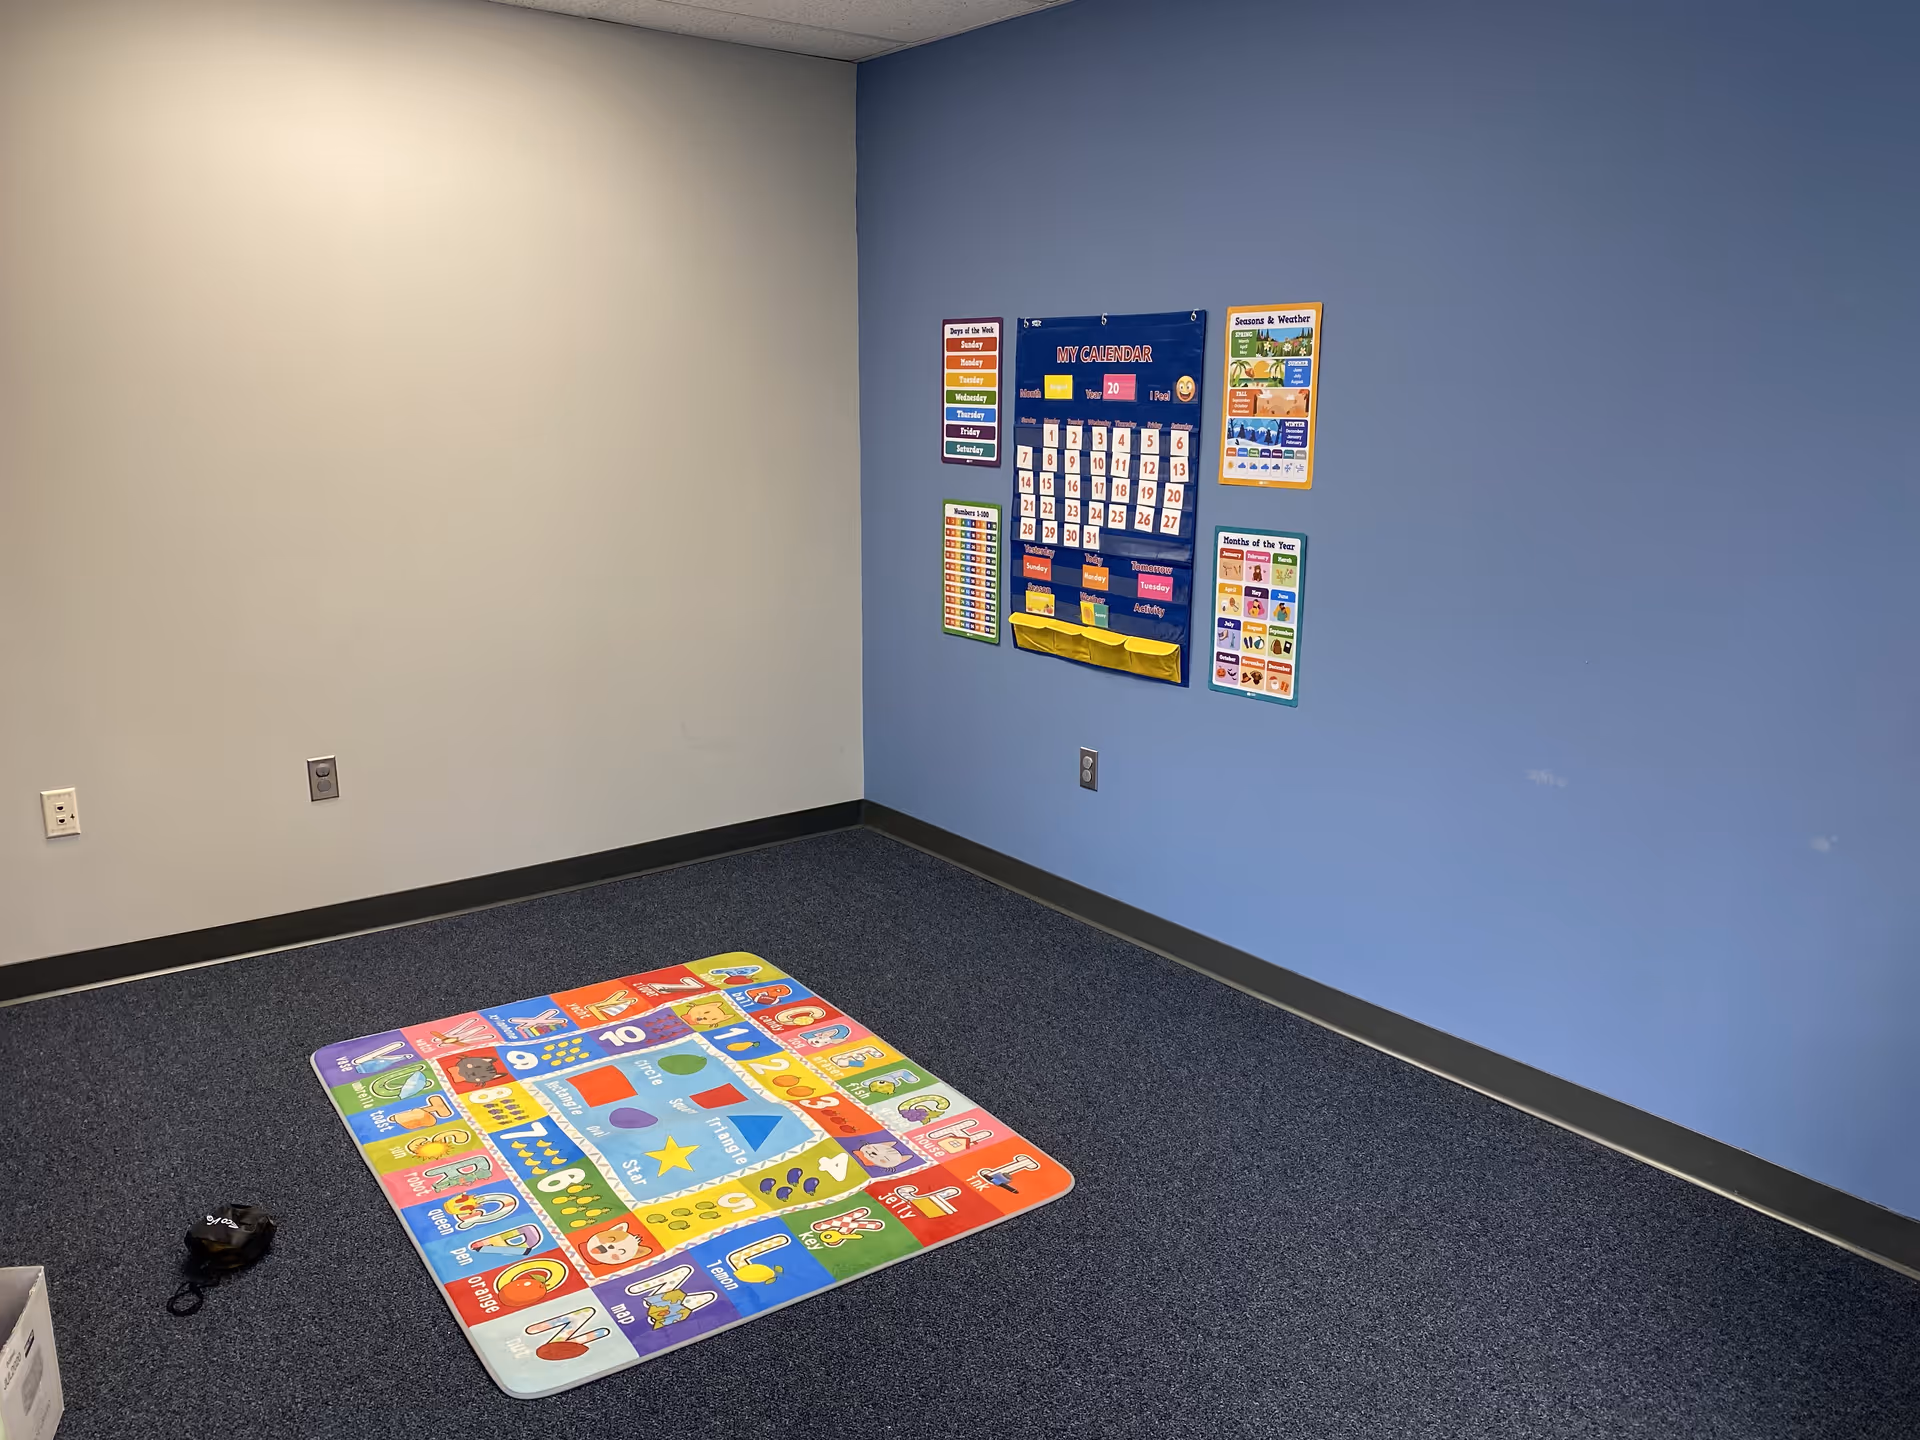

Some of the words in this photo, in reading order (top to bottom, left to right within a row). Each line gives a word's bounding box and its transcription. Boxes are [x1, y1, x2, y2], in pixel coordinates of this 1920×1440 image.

[1235, 316, 1264, 325] Seasons
[1267, 316, 1274, 324] &
[1277, 314, 1310, 324] Weather
[950, 327, 963, 336] Days
[981, 326, 994, 334] Week
[961, 340, 983, 350] Sunday
[1057, 346, 1079, 363] MY
[1080, 345, 1153, 363] CALENDAR
[960, 358, 983, 368] Monday
[959, 376, 984, 385] Tuesday
[955, 393, 987, 404] Wednesday
[1019, 388, 1042, 399] Month
[1085, 389, 1102, 400] Year
[1107, 382, 1120, 395] 20
[1154, 390, 1171, 401] Feel
[956, 410, 985, 421] Thursday
[1115, 420, 1137, 429] Thursday
[1147, 421, 1163, 430] Friday
[1171, 423, 1193, 431] Saturday
[960, 427, 980, 438] Friday
[1050, 430, 1053, 441] 1
[1072, 432, 1077, 443] 2
[1098, 433, 1103, 444] 3
[1118, 434, 1124, 446] 4
[1147, 435, 1153, 447] 5
[1176, 437, 1183, 449] 6
[956, 444, 983, 456] Saturday
[1023, 452, 1028, 462] 7
[1048, 454, 1053, 465] 8
[1070, 456, 1075, 467] 9
[1094, 458, 1104, 469] 10
[1116, 458, 1126, 471] 11
[1144, 462, 1155, 474] 12
[1174, 463, 1185, 476] 13
[1021, 477, 1031, 487] 14
[1042, 478, 1052, 489] 15
[1068, 480, 1078, 492] 16
[1095, 482, 1104, 494] 17
[1116, 484, 1127, 496] 18
[1142, 487, 1154, 499] 19
[1167, 489, 1181, 502] 20
[954, 508, 975, 517] Numbers
[1024, 500, 1033, 511] 21
[1042, 502, 1053, 514] 22
[1067, 505, 1078, 517] 23
[1091, 508, 1102, 520] 24
[1111, 510, 1124, 523] 25
[1138, 512, 1150, 526] 26
[1163, 515, 1178, 528] 27
[1022, 523, 1033, 535] 28
[1045, 527, 1055, 538] 29
[1066, 530, 1077, 542] 30
[1086, 532, 1096, 544] 31
[1223, 536, 1249, 546] Months
[1252, 539, 1260, 547] of
[1263, 539, 1275, 549] the
[1279, 541, 1295, 550] Year
[1024, 543, 1055, 559] Yesterday
[1084, 552, 1103, 567] Today
[1222, 550, 1241, 558] January
[1026, 562, 1048, 574] Sunday
[1084, 572, 1106, 584] Monday
[1131, 561, 1173, 575] Tomorrow
[1027, 582, 1051, 594] Season
[1080, 591, 1105, 604] Weather
[1140, 581, 1170, 594] Tuesday
[1133, 603, 1165, 618] Activity
[1270, 628, 1293, 636] September
[1242, 659, 1264, 667] November
[1268, 664, 1290, 672] December
[648, 977, 705, 995] Z
[745, 984, 793, 1005] B
[584, 990, 638, 1021] Y
[732, 991, 755, 1008] ball
[508, 1009, 568, 1031] X
[566, 1002, 592, 1020] yacht
[775, 1006, 826, 1026] C
[759, 1015, 784, 1031] candy
[599, 1025, 647, 1047] 10
[714, 1027, 749, 1040] 1
[336, 1056, 353, 1072] vase
[506, 1050, 539, 1070] 9
[747, 1057, 790, 1075] 2
[811, 1056, 844, 1077] eraser
[830, 1045, 886, 1068] E
[369, 1064, 434, 1099] U
[861, 1068, 920, 1089] F
[468, 1086, 513, 1104] 8
[545, 1081, 584, 1116] Rectangle
[845, 1082, 871, 1099] fish
[387, 1094, 454, 1125] T
[799, 1096, 840, 1109] 3
[370, 1110, 395, 1133] toast
[500, 1121, 548, 1140] 7
[927, 1118, 994, 1145] H
[405, 1129, 471, 1157] S
[705, 1116, 748, 1165] Triangle
[913, 1133, 946, 1158] house
[389, 1146, 407, 1160] sun
[422, 1155, 493, 1193] R
[622, 1158, 647, 1188] Star
[818, 1152, 849, 1182] 4
[977, 1154, 1041, 1186] I
[404, 1172, 432, 1197] robot
[537, 1168, 586, 1193] 6
[965, 1175, 990, 1192] ink
[717, 1192, 757, 1213] 5
[878, 1191, 917, 1220] jelly
[894, 1184, 961, 1216] J
[448, 1192, 519, 1231] Q
[428, 1208, 454, 1236] queen
[811, 1207, 885, 1247] K
[468, 1223, 544, 1256] P
[798, 1231, 824, 1251] key
[450, 1247, 473, 1266] pen
[725, 1233, 791, 1274] L
[493, 1257, 569, 1303] O
[707, 1259, 738, 1291] lemon
[468, 1276, 500, 1313] orange
[625, 1264, 718, 1323] M
[611, 1303, 636, 1325] map
[525, 1306, 612, 1346] N
[506, 1336, 532, 1360] nut
